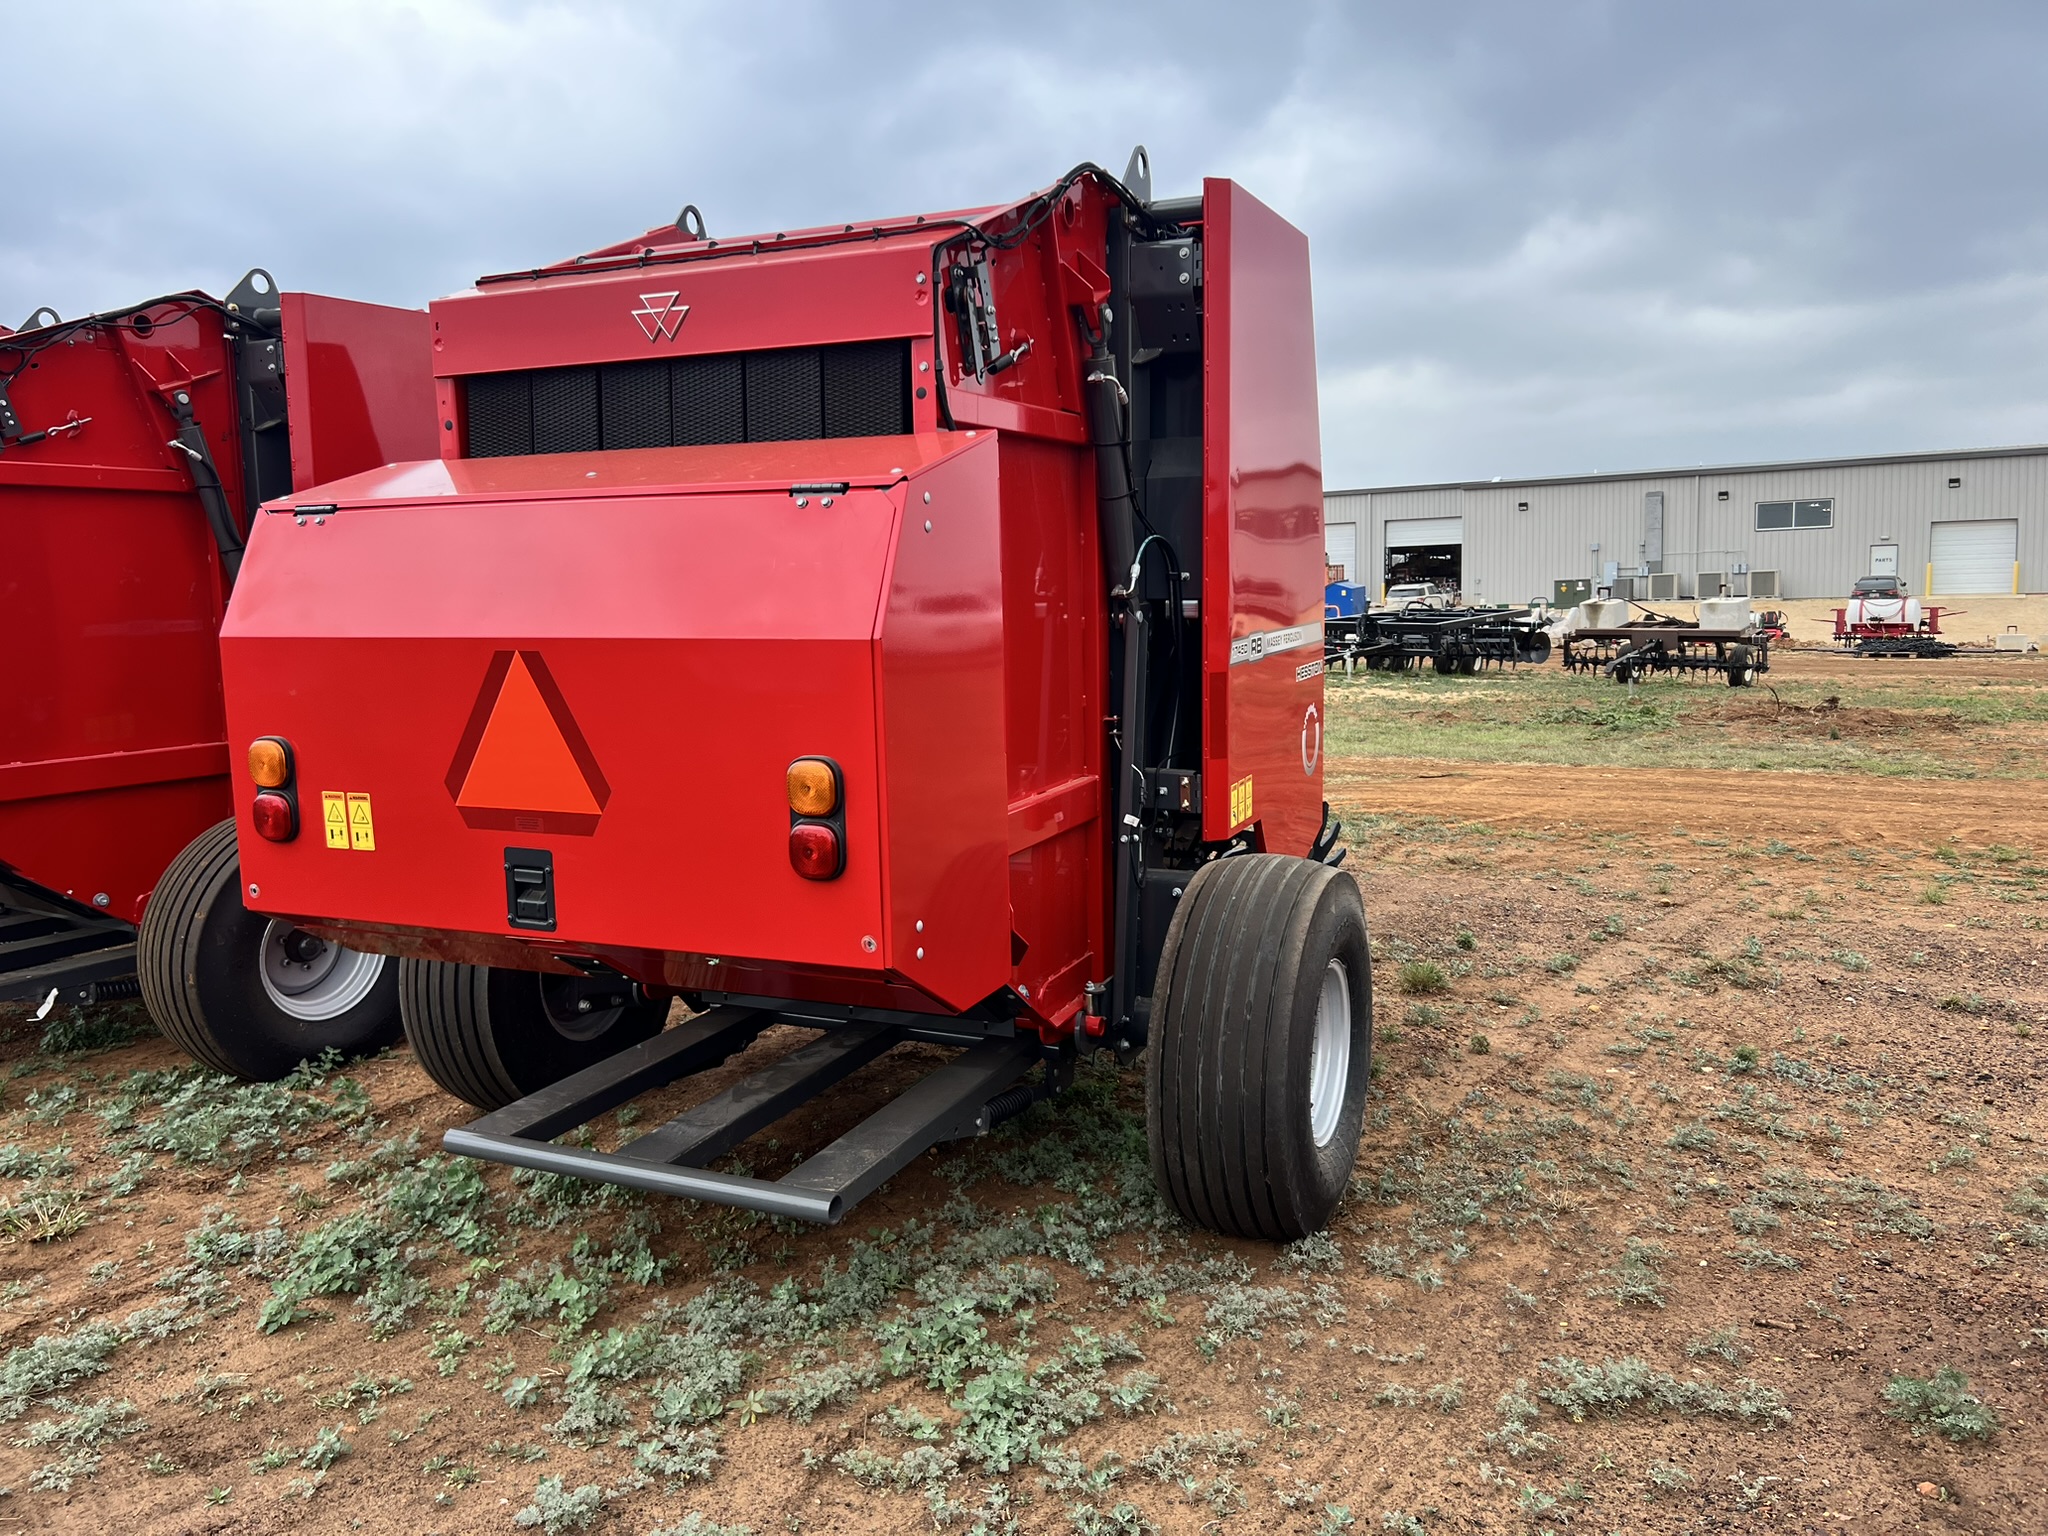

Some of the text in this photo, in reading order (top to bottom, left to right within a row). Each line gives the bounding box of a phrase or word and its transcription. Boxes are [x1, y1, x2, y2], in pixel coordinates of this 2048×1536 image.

[1250, 637, 1262, 655] RB
[1266, 635, 1282, 649] MASSEY
[1283, 630, 1303, 644] FERGUSON
[1296, 659, 1324, 682] HESSTON
